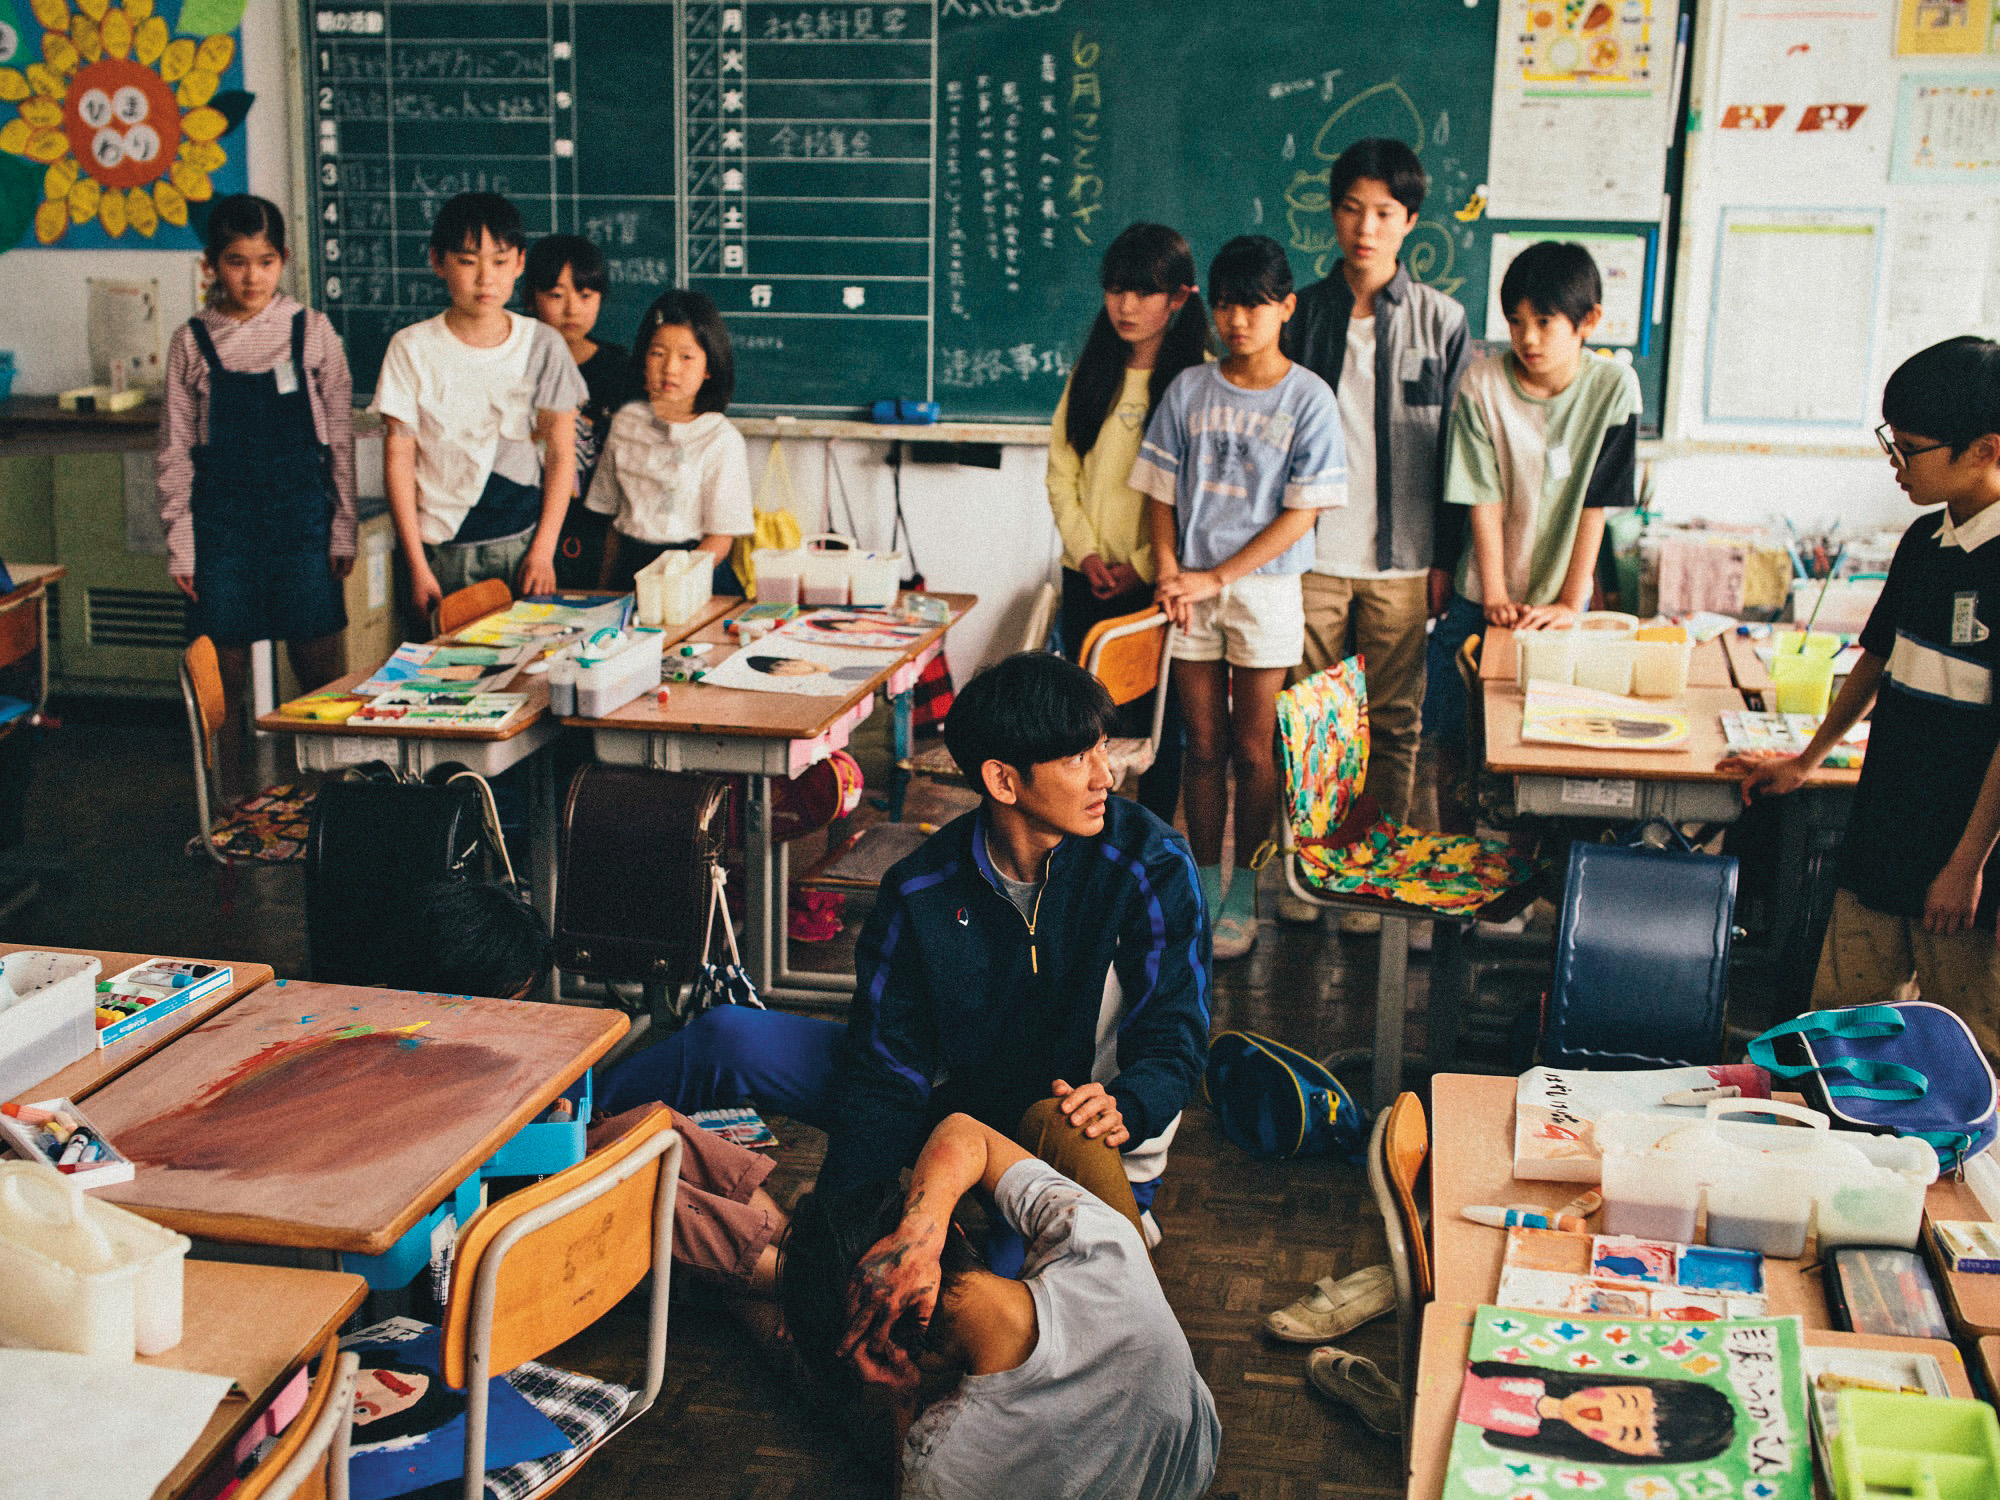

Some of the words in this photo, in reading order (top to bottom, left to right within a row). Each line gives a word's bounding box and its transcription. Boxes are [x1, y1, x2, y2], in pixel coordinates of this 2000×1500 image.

[723, 9, 743, 33] 月
[320, 51, 330, 72] 1
[722, 49, 744, 72] 火
[319, 87, 333, 110] 2
[722, 89, 744, 113] 水
[722, 129, 744, 152] 木
[321, 163, 337, 187] 3
[723, 168, 744, 191] 金
[324, 202, 338, 224] 4
[724, 206, 744, 229] 土
[326, 239, 341, 262] 5
[724, 244, 743, 267] 日
[327, 276, 341, 300] 6
[751, 284, 773, 308] 行
